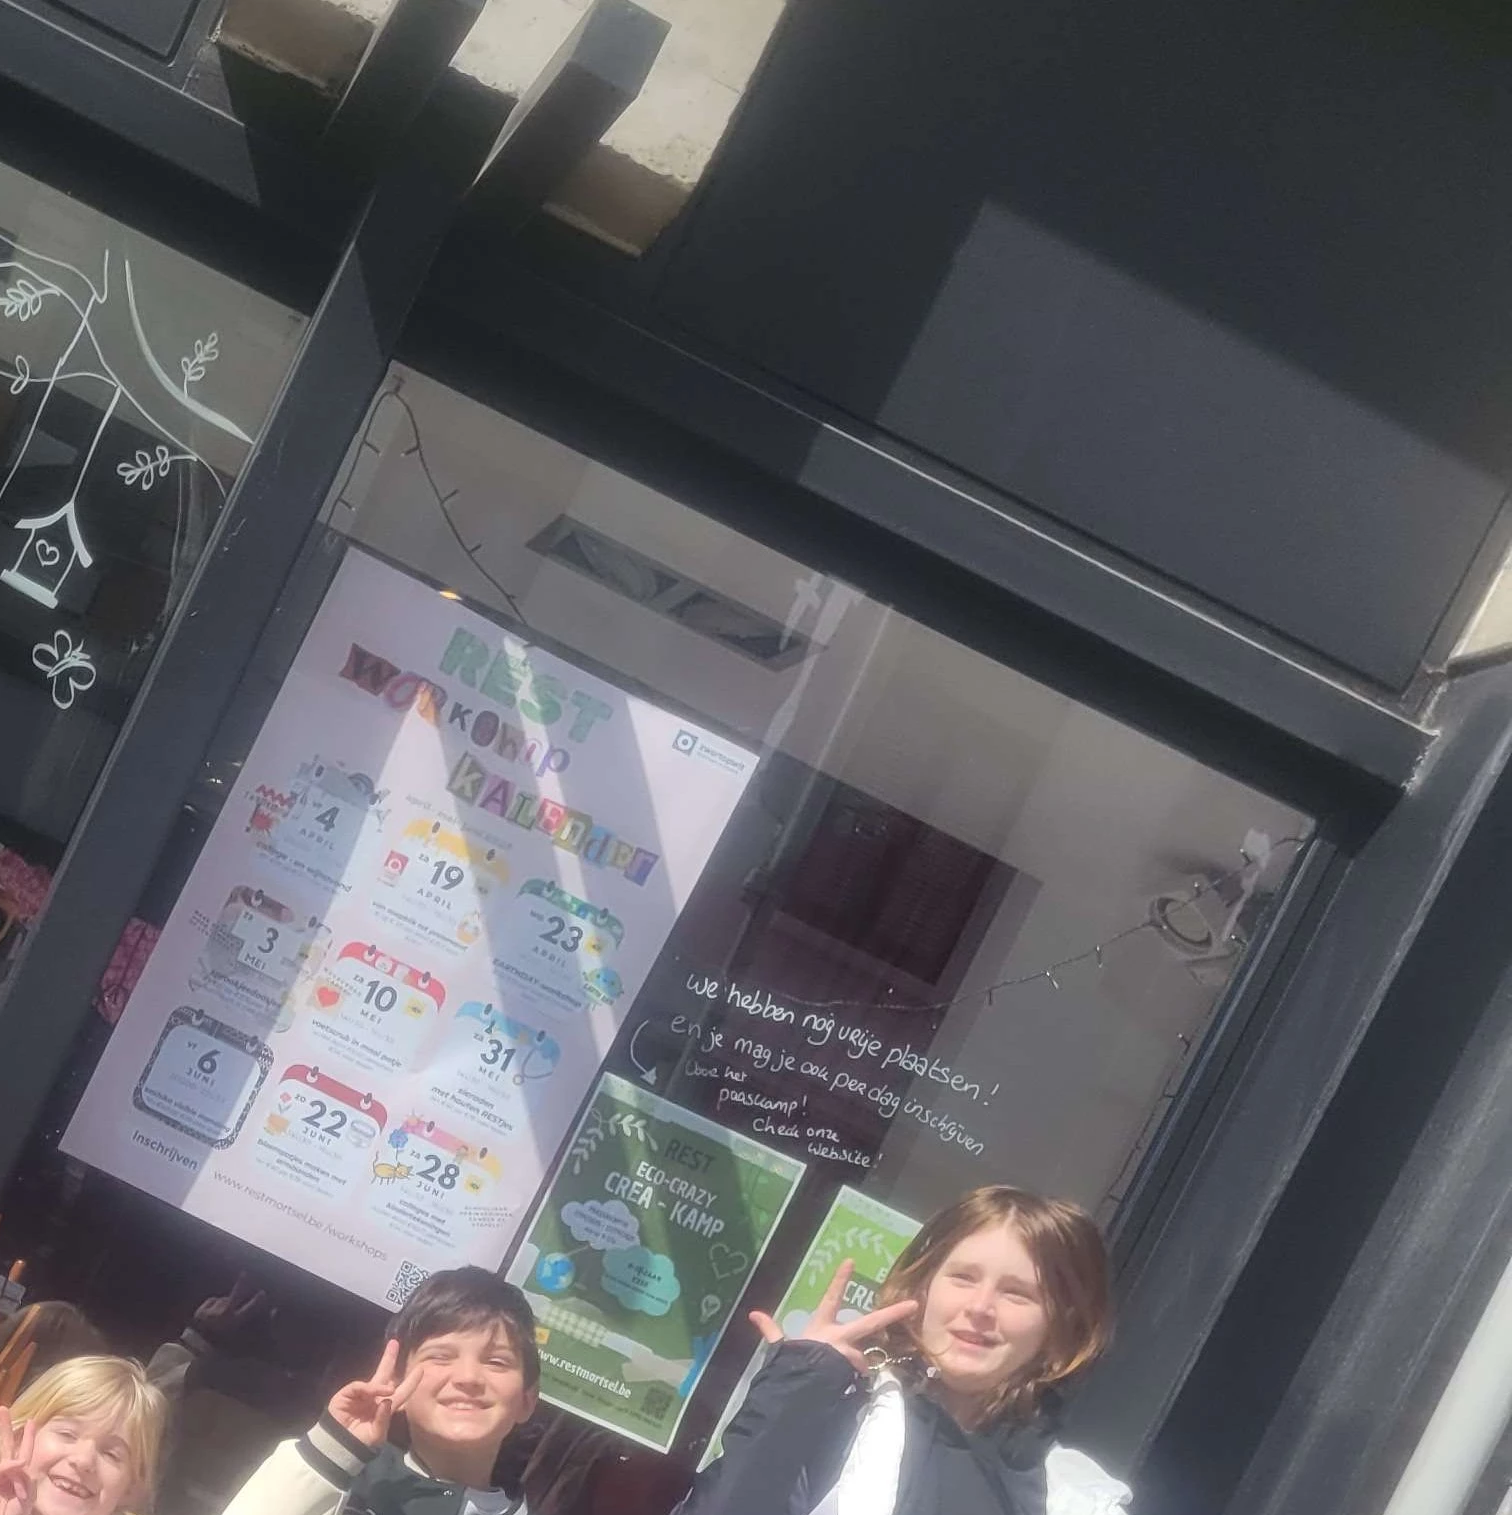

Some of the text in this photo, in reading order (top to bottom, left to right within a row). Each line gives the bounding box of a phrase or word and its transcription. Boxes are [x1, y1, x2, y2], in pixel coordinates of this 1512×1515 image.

[440, 628, 613, 743] REST
[315, 804, 339, 832] 4
[431, 861, 464, 890] 19
[415, 886, 453, 911] APRIL
[258, 928, 278, 953] 3
[539, 916, 583, 952] 23
[242, 952, 267, 971] MEI
[530, 944, 567, 967] APRIL
[364, 981, 397, 1012] 10
[358, 1008, 382, 1025] MEI
[727, 983, 795, 1024] hebben
[802, 1013, 836, 1046] nog
[198, 1050, 220, 1074] 6
[481, 1039, 518, 1072] 31
[671, 1015, 701, 1039] en
[701, 1027, 724, 1053] je
[734, 1038, 772, 1069] mag
[770, 1050, 795, 1073] je
[867, 1085, 901, 1119] dag
[184, 1066, 216, 1087] JUNI
[476, 1065, 501, 1082] MEI
[302, 1101, 347, 1138] 22
[300, 1125, 333, 1146] JUNI
[806, 1127, 841, 1143] onze
[131, 1129, 200, 1173] Inschrijven
[664, 1140, 716, 1173] REST
[416, 1155, 459, 1189] 28
[636, 1161, 719, 1208] ECO-CRAZY
[415, 1179, 446, 1200] JUNI
[603, 1170, 654, 1209] CREA
[669, 1201, 725, 1238] KAMP
